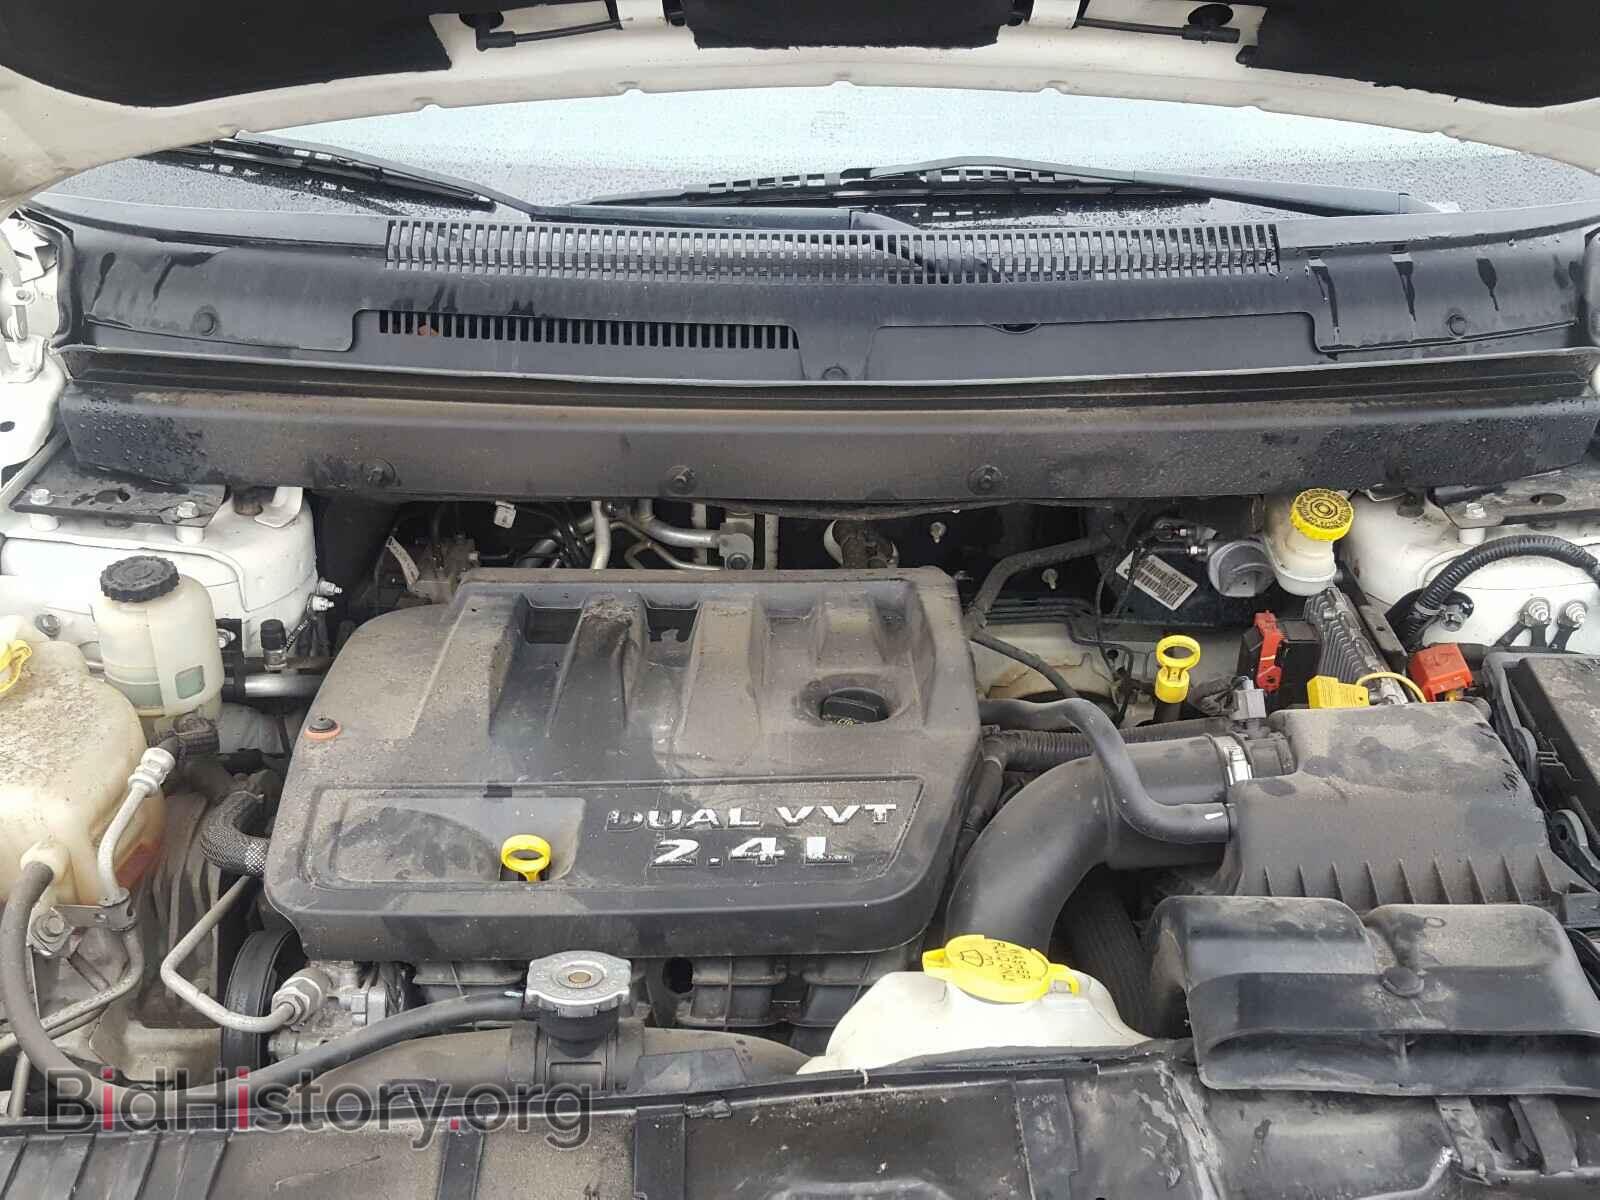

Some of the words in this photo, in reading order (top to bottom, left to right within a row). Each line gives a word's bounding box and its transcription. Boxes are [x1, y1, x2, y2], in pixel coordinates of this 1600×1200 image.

[606, 805, 762, 832] DUAL
[775, 803, 898, 828] VVT
[649, 836, 853, 868] 2.4L
